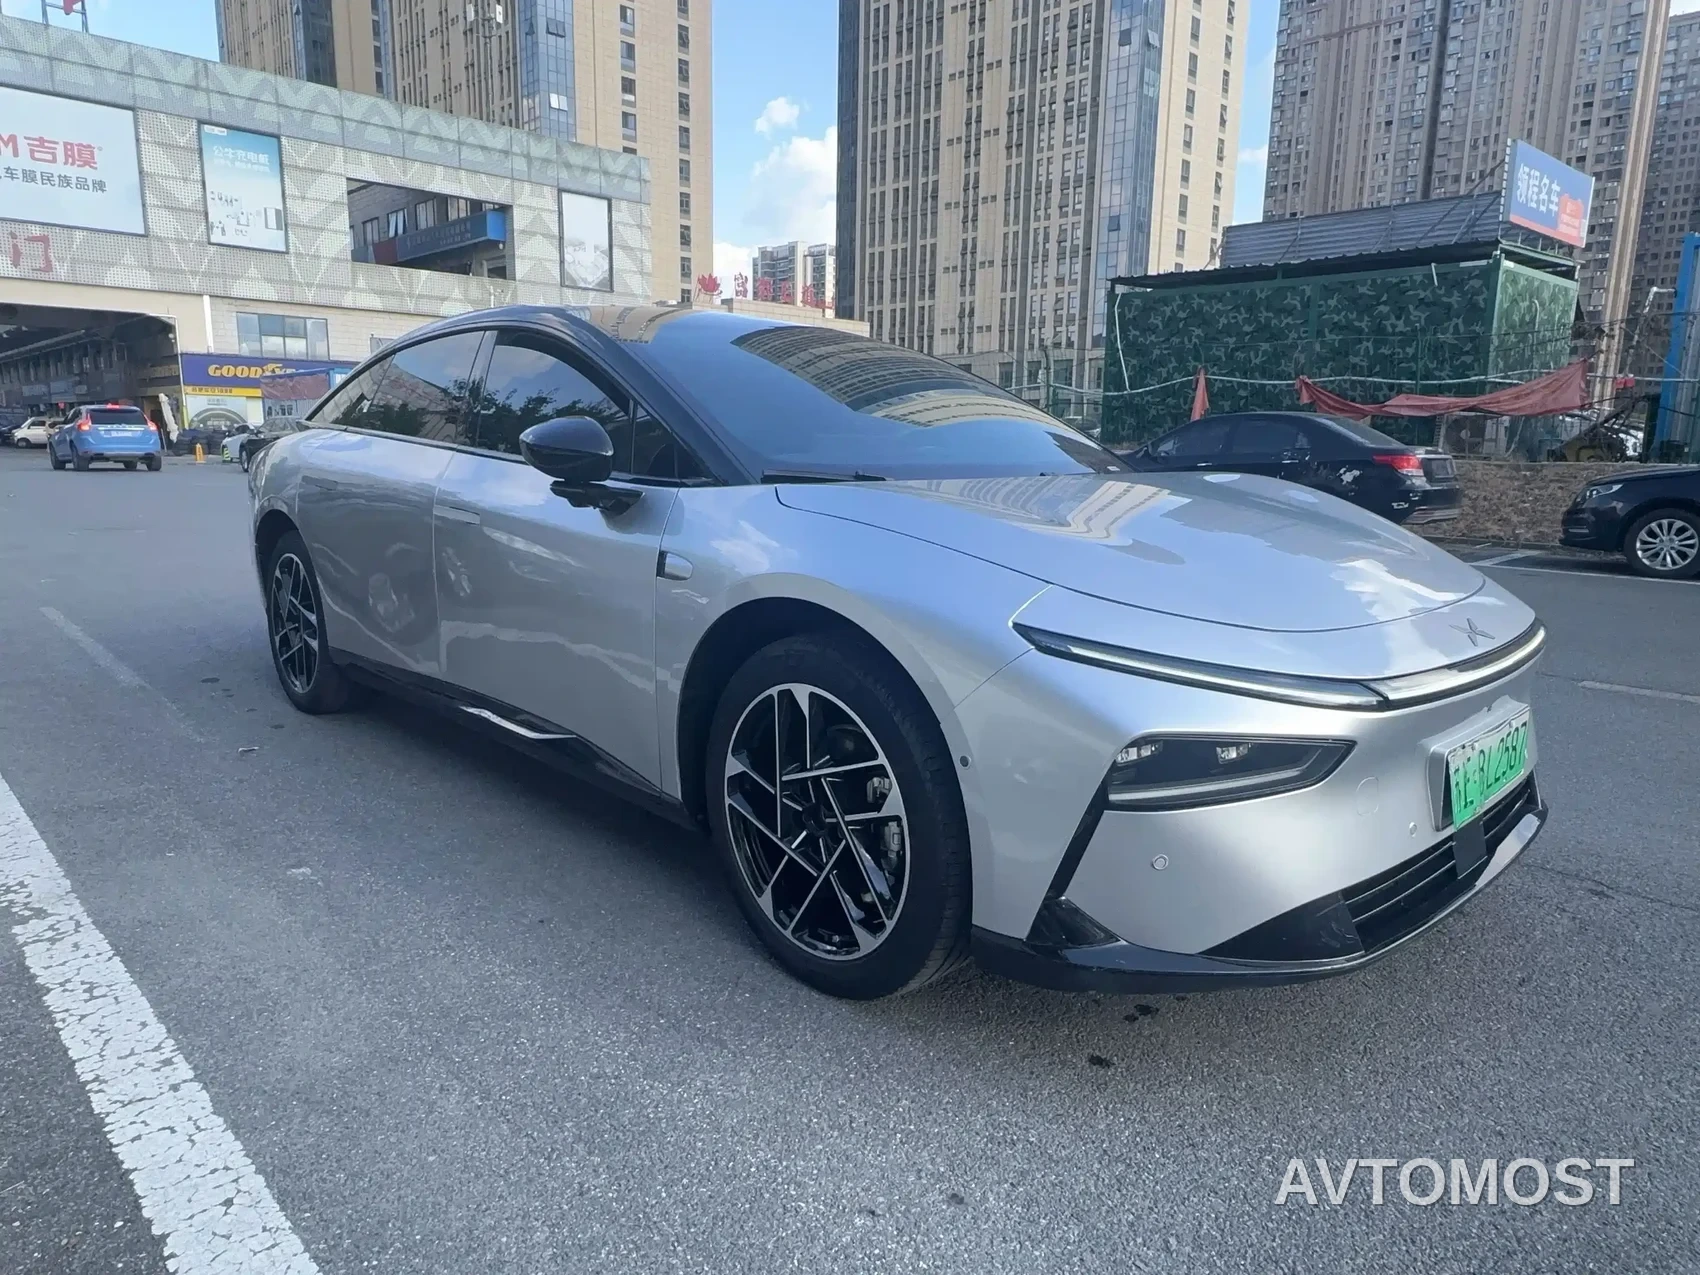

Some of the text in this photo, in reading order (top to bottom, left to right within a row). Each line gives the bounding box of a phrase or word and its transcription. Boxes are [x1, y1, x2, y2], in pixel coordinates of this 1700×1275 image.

[0, 166, 107, 193] 车膜民族品牌
